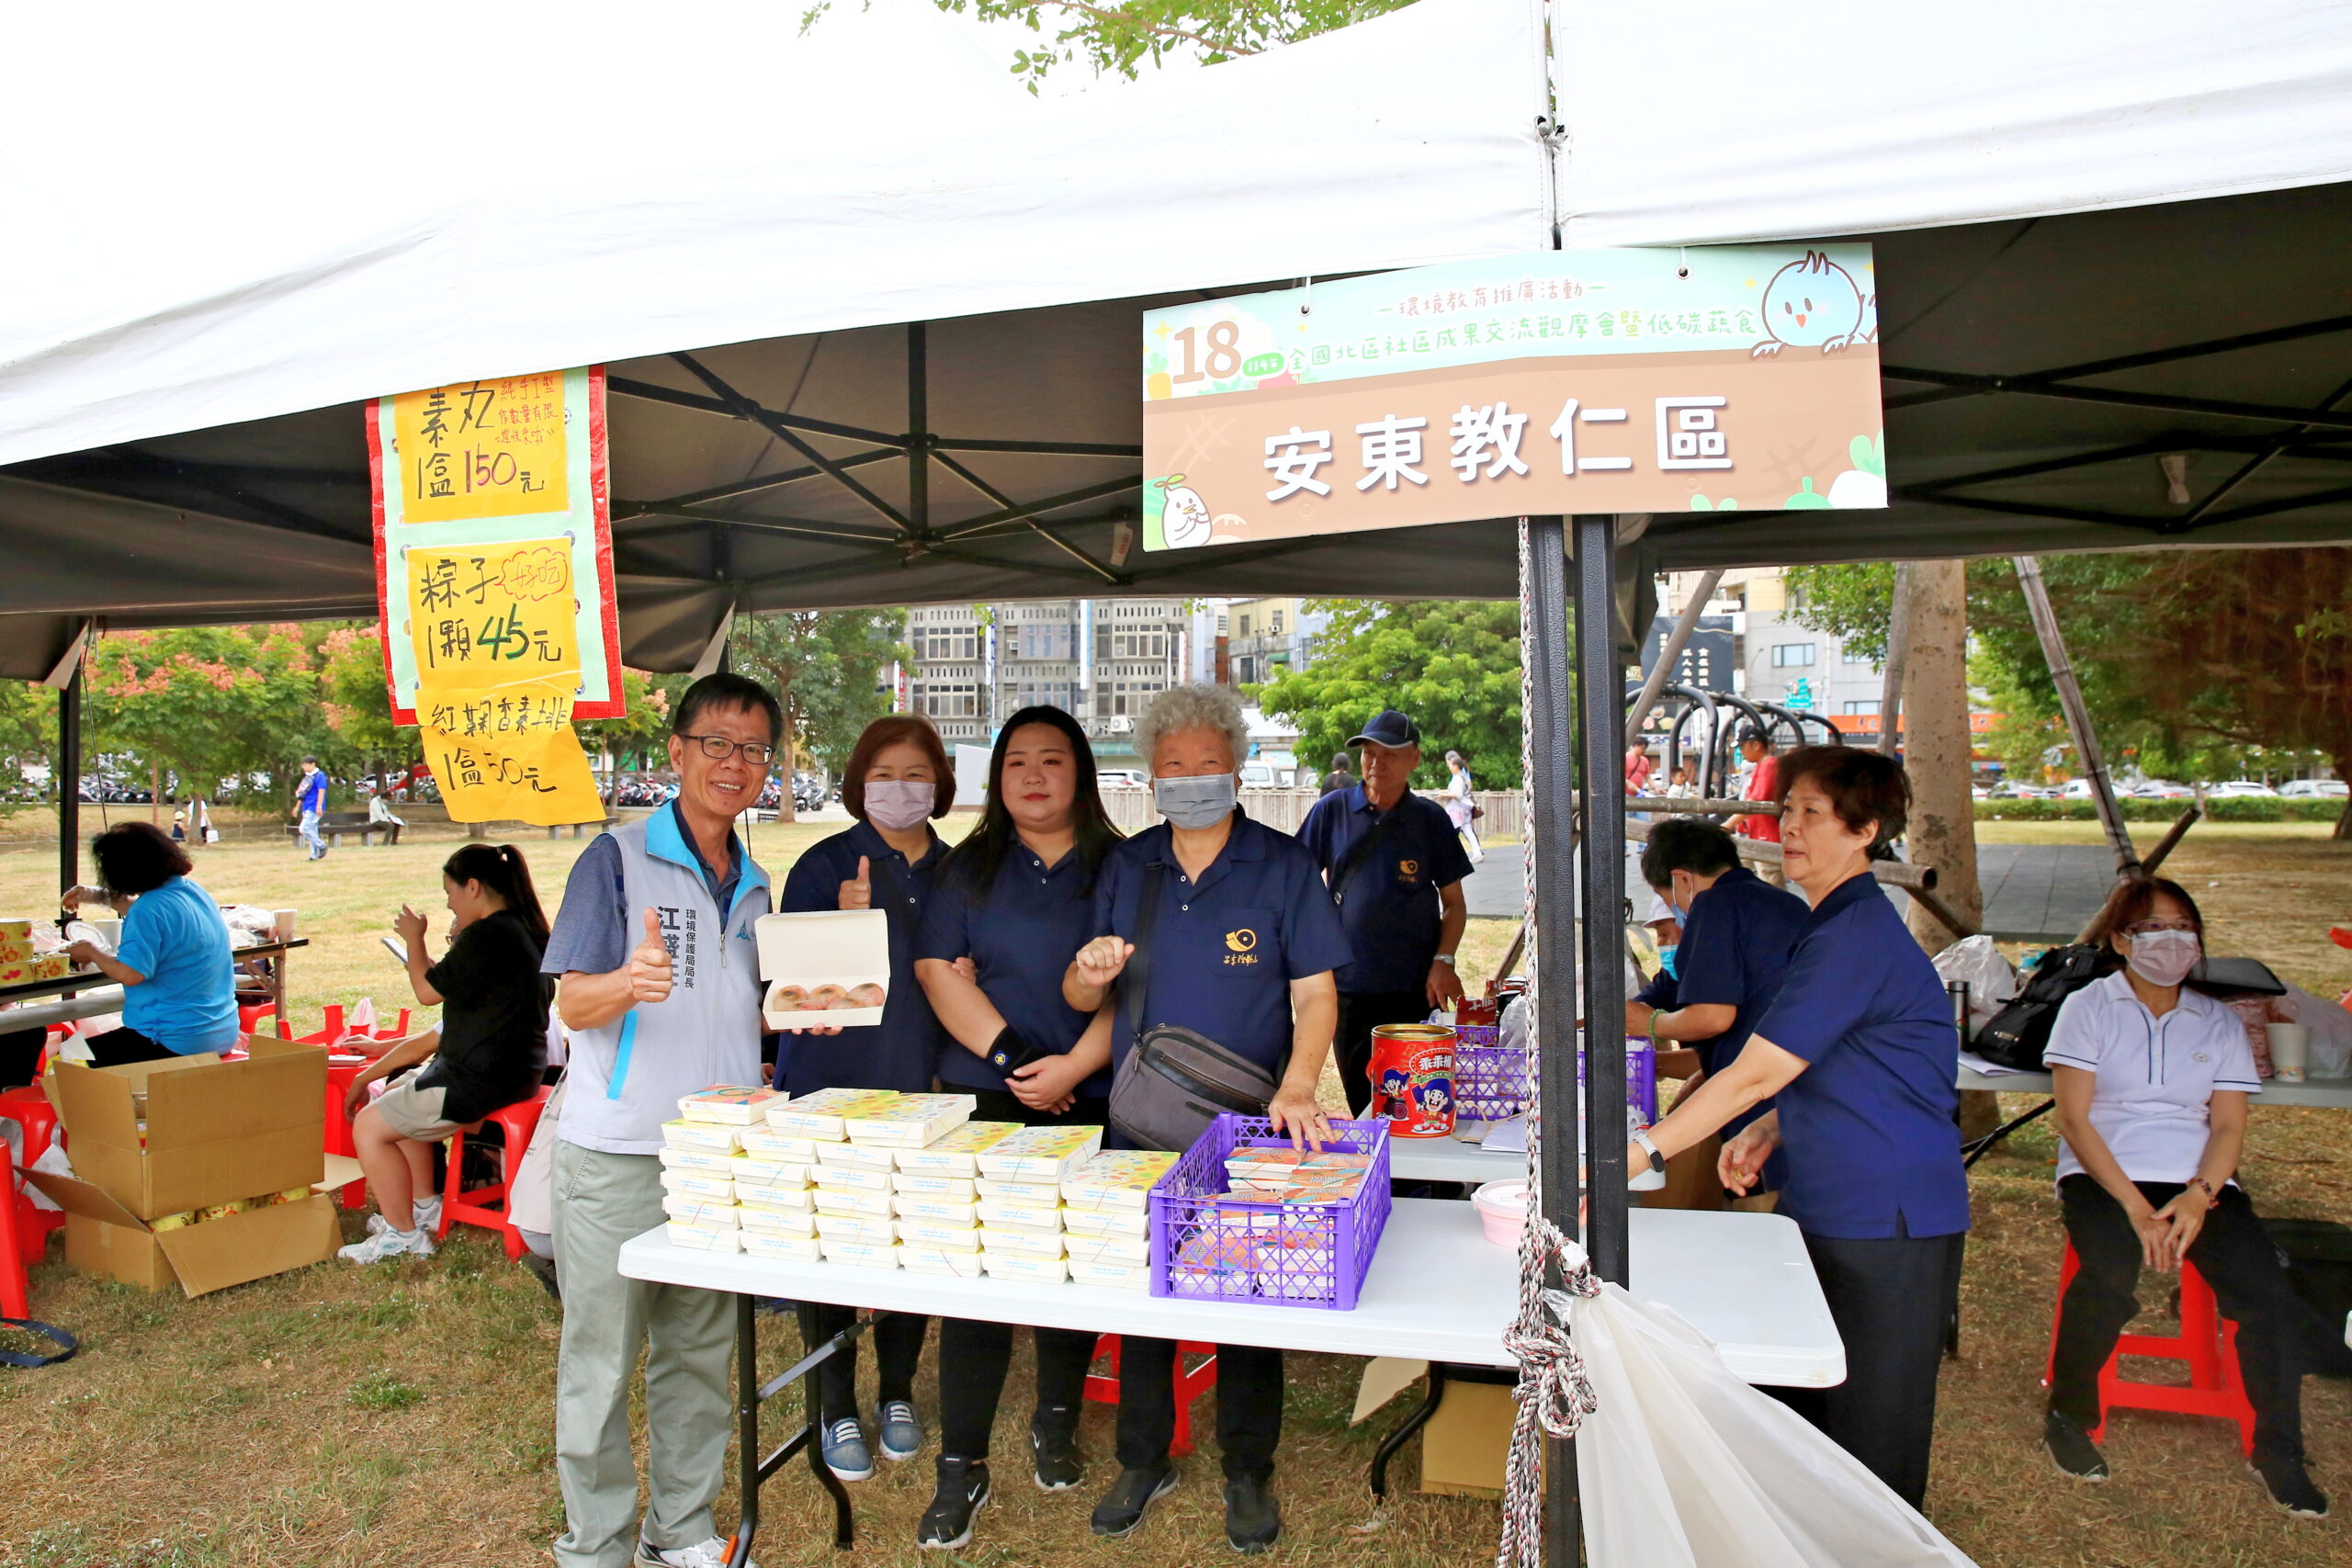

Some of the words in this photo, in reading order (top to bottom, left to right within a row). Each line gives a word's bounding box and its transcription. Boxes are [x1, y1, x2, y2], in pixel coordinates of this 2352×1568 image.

[1173, 321, 1242, 385] 18
[1264, 396, 1734, 502] 安東教仁區
[510, 558, 560, 589] 好吃
[684, 908, 696, 989] 環境保護局局長
